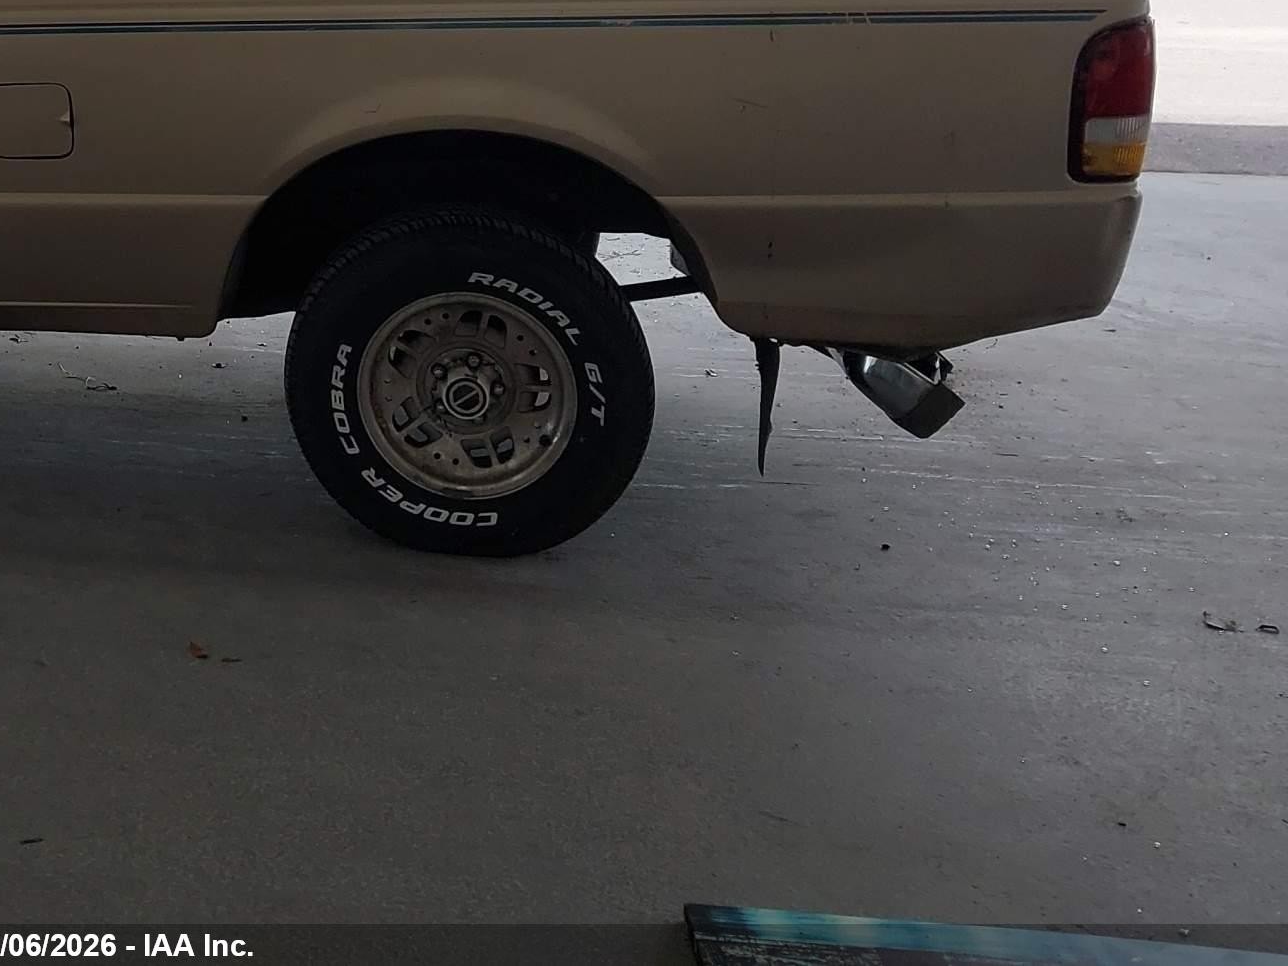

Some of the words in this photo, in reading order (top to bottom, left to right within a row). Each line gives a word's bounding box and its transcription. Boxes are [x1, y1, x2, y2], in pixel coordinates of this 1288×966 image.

[329, 343, 360, 455] COBRA
[466, 271, 583, 346] RADIAL
[583, 361, 608, 427] G/T
[361, 467, 499, 527] COOPER
